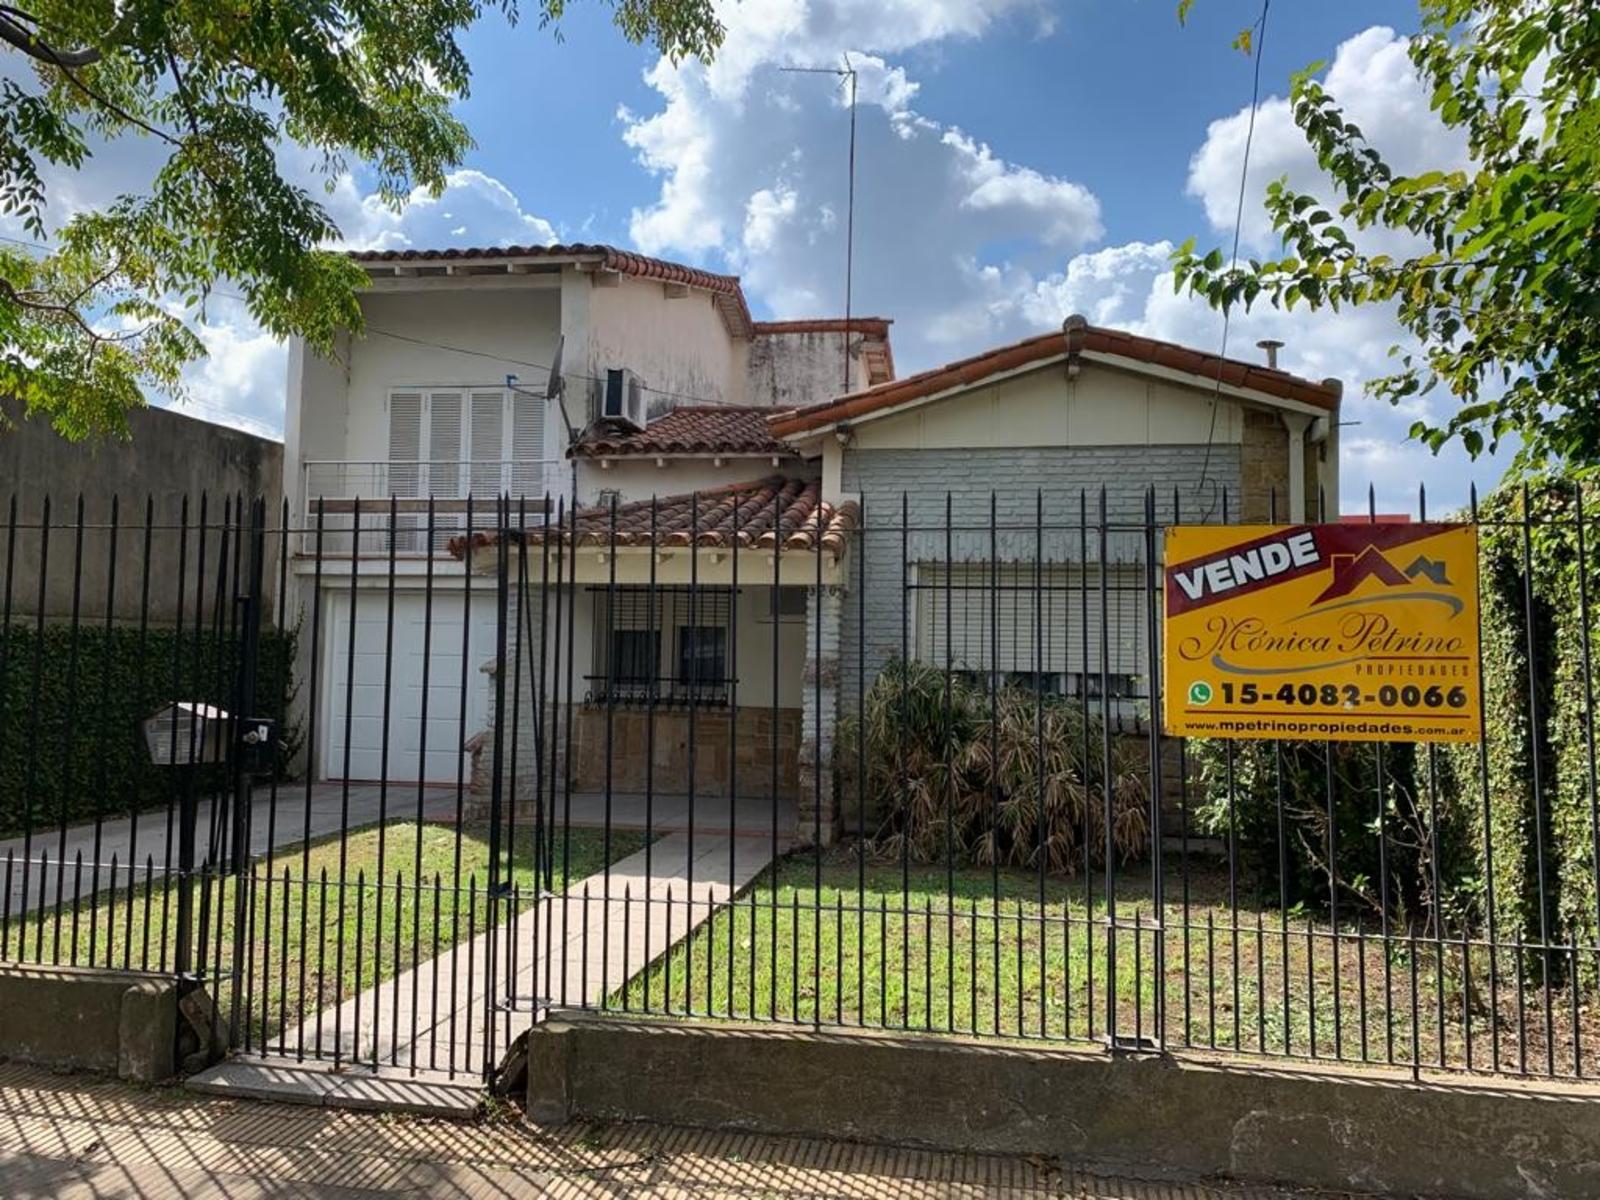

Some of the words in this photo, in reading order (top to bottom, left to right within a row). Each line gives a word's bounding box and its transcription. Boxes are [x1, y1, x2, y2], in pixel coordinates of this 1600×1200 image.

[1175, 532, 1320, 601] VENDE
[1179, 616, 1331, 660] Mónica
[1337, 611, 1465, 652] Petrino
[1355, 663, 1469, 676] PROPIEDADES
[1221, 682, 1467, 708] 15-4082-0066
[1184, 720, 1466, 735] www.mpetrinopropiedades.com.ar
